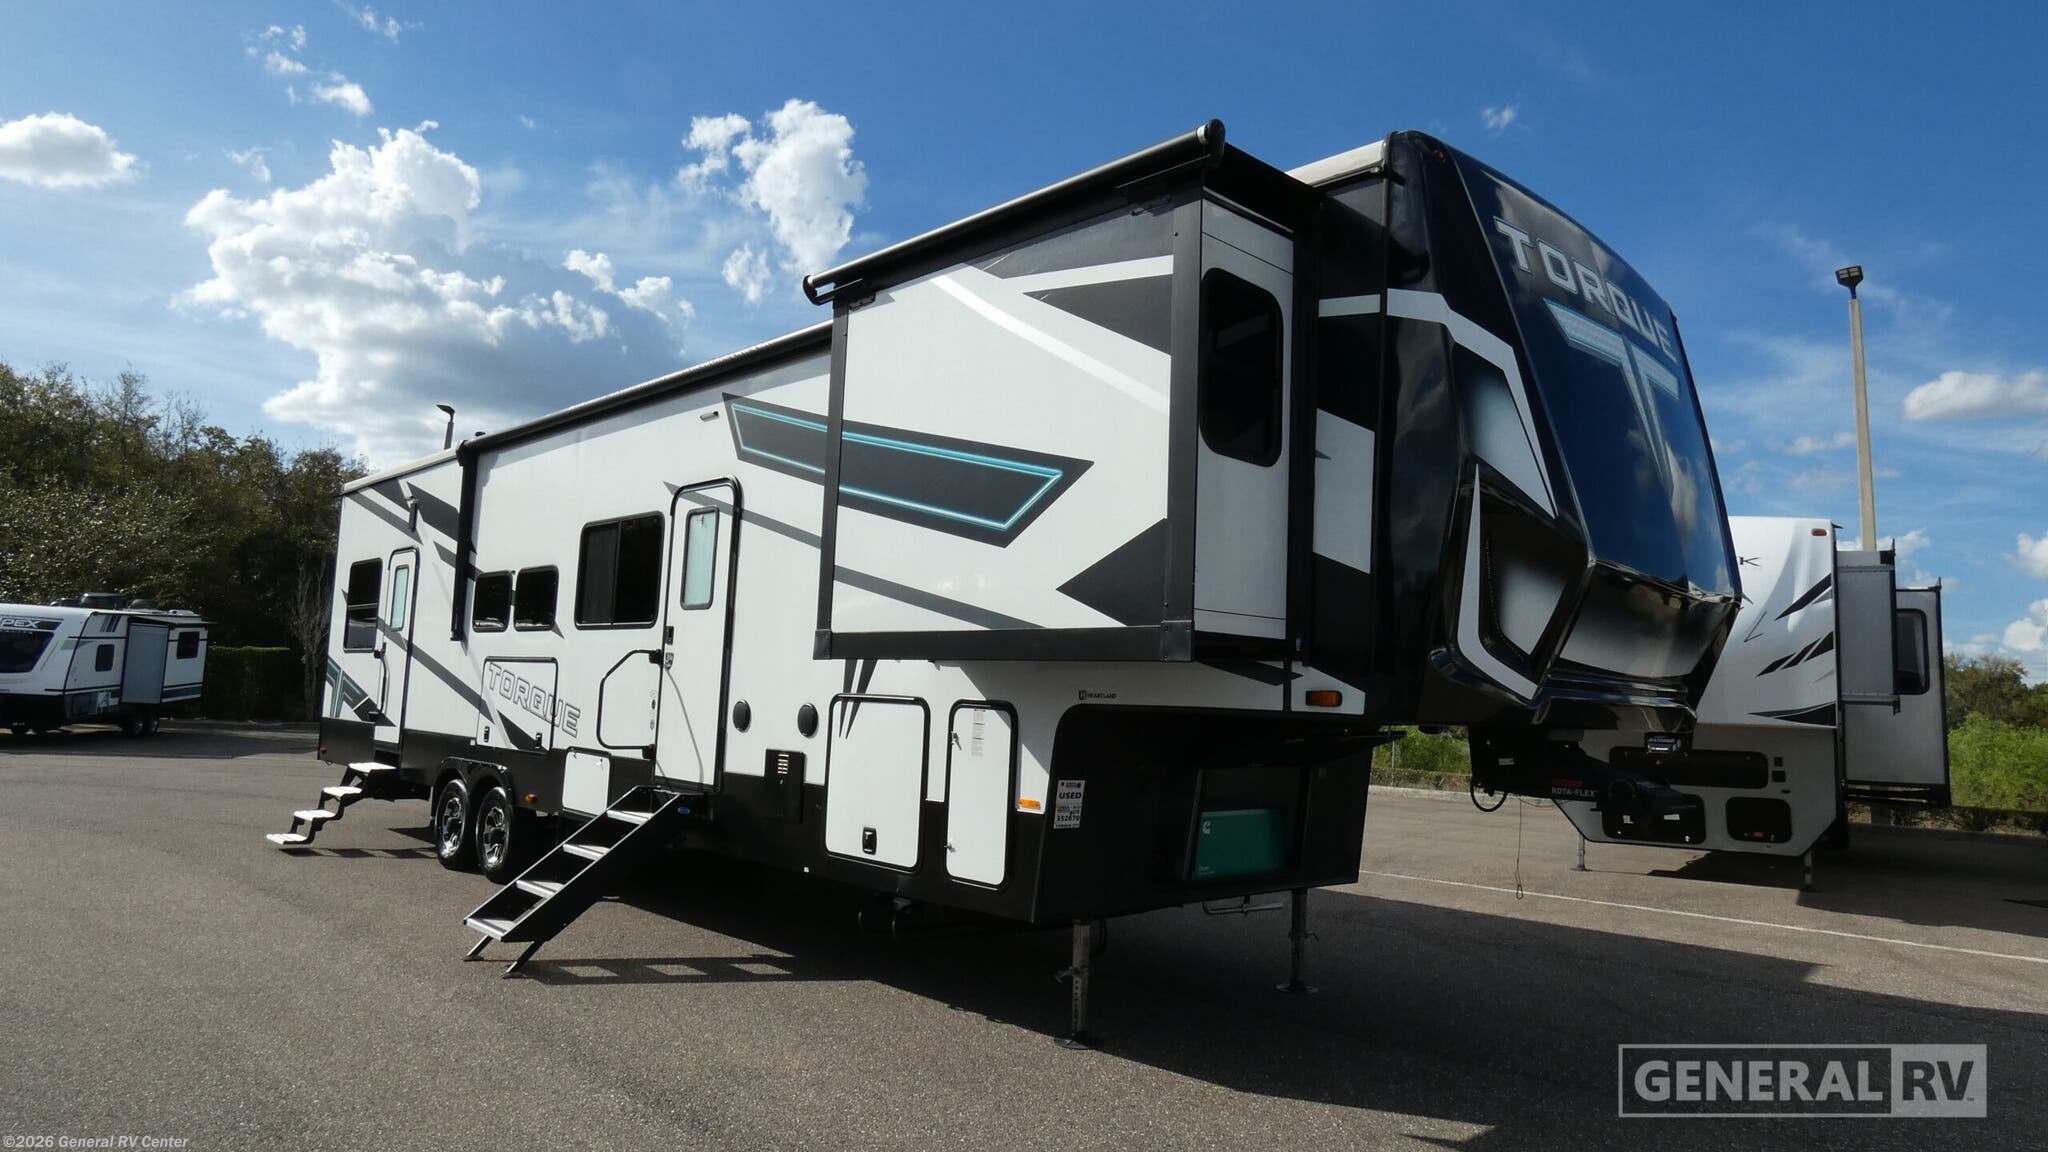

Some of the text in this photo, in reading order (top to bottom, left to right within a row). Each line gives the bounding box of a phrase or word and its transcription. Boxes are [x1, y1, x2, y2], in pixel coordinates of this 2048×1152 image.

[1493, 216, 1678, 363] TORQUE
[0, 616, 40, 629] PEX
[489, 662, 581, 739] TORQUE
[1059, 792, 1082, 800] USED
[1551, 786, 1597, 798] ROTA-FLEX
